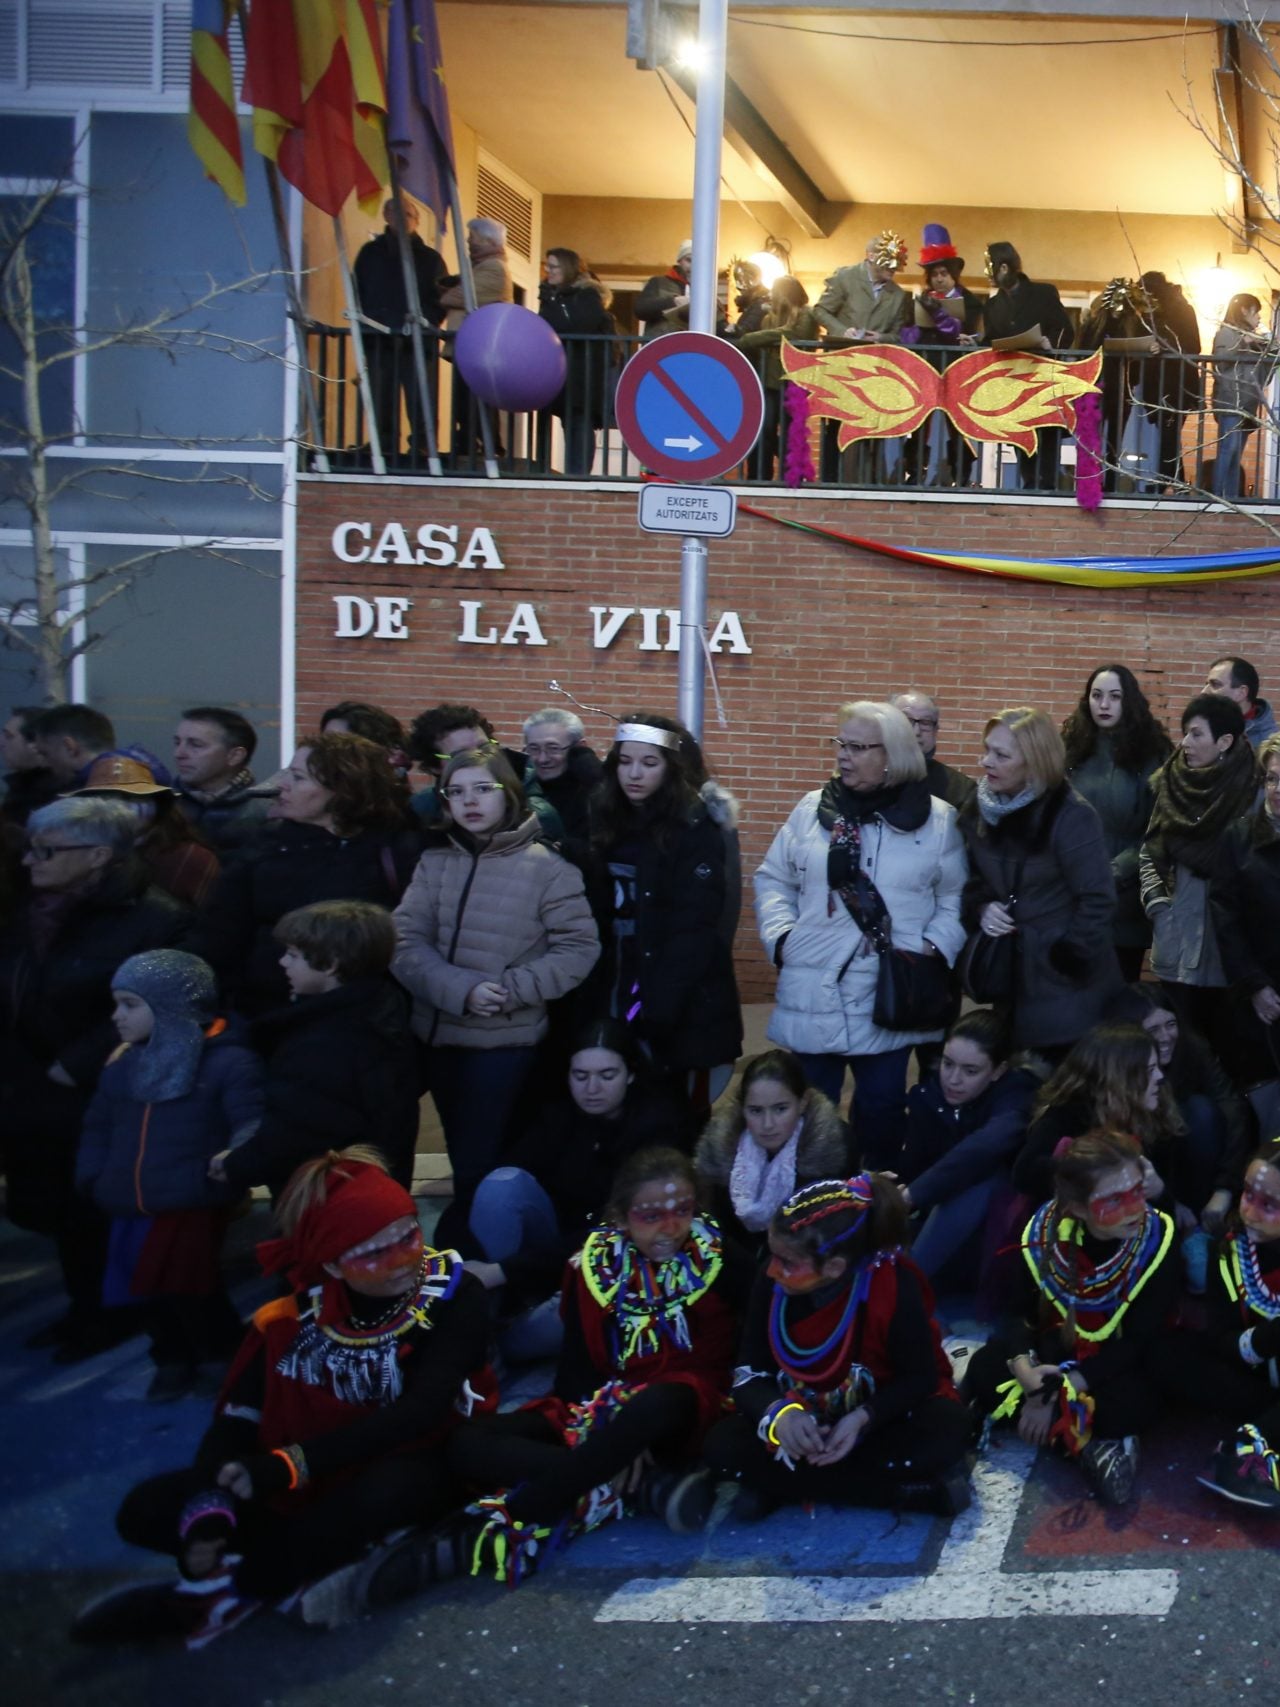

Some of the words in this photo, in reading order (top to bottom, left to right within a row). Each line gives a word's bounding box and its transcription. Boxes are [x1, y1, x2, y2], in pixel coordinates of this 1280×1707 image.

[656, 509, 719, 521] AUTORITZATS
[667, 496, 709, 508] EXCEPTE
[332, 521, 505, 570] CASA
[332, 595, 414, 639] DE
[457, 600, 548, 646] LA
